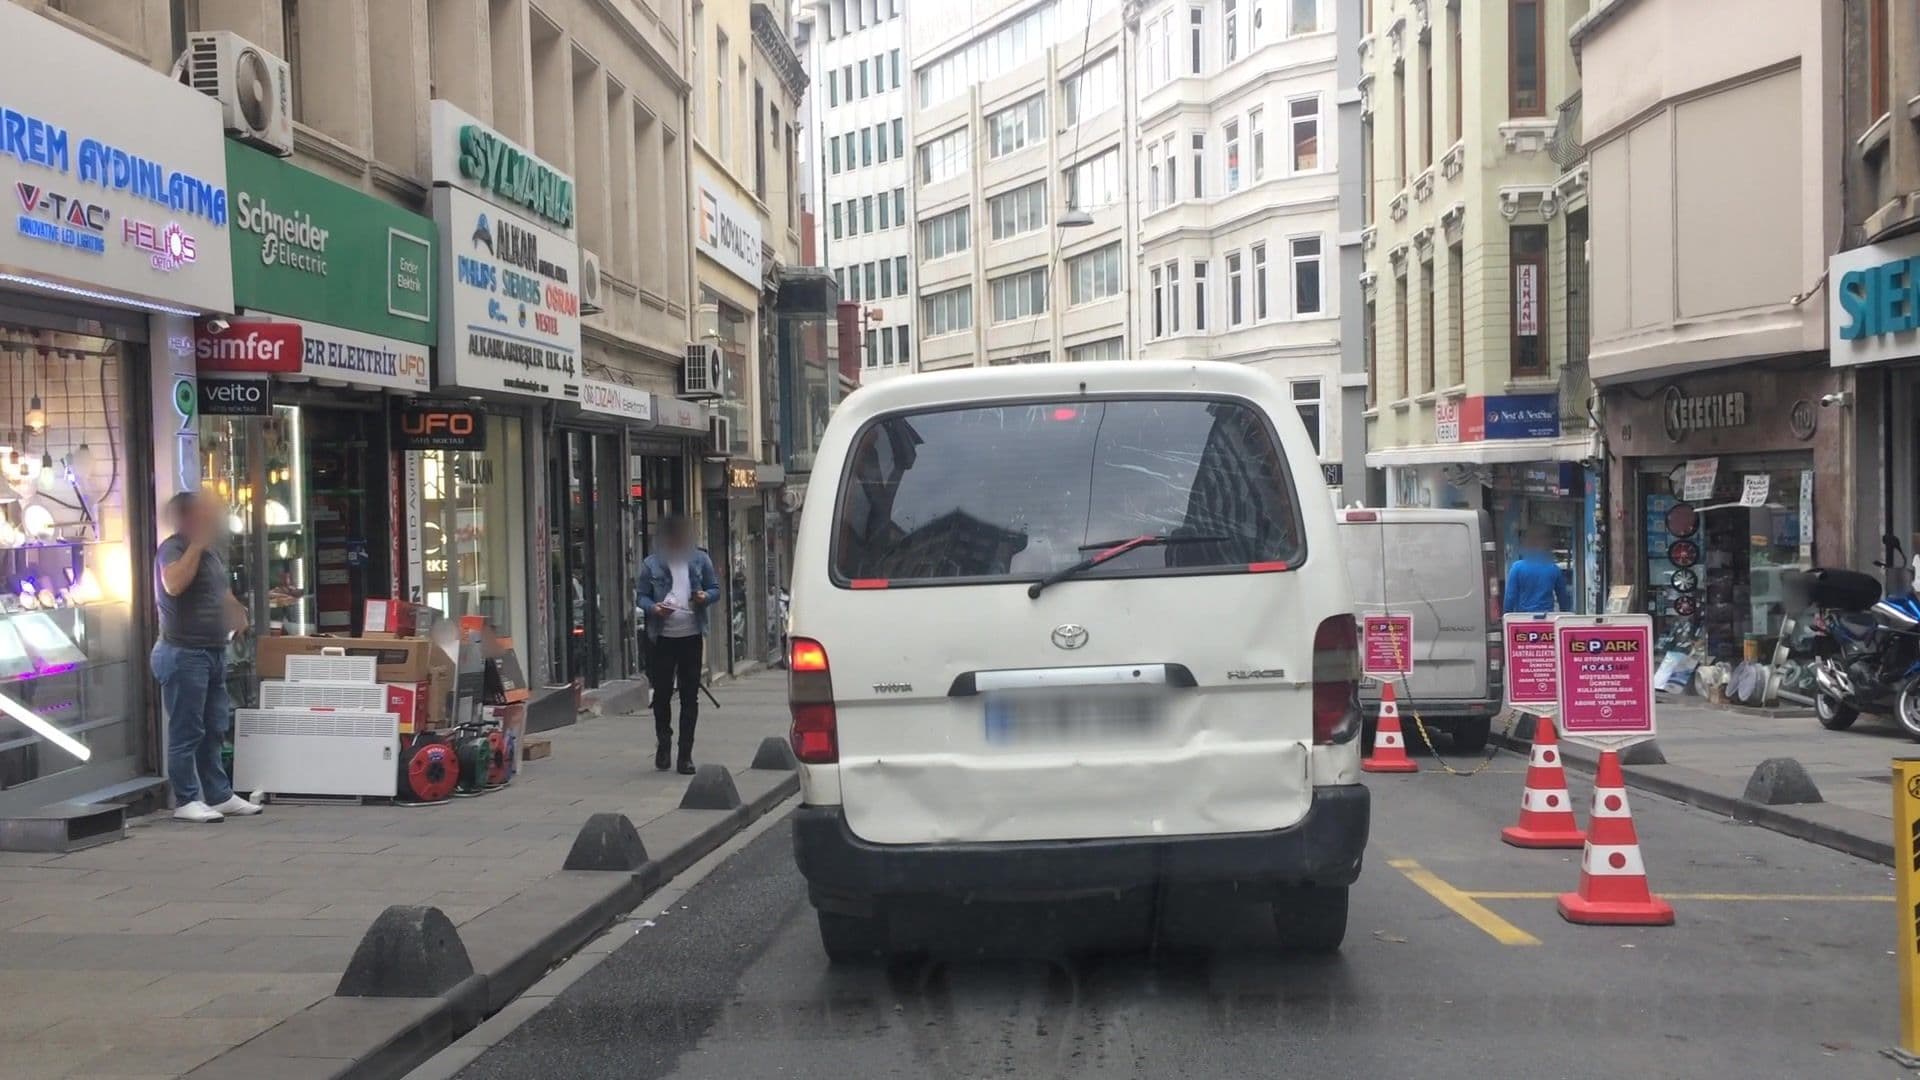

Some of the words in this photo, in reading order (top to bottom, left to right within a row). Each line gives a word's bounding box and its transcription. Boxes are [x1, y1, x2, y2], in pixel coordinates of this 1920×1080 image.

[78, 137, 226, 226] AYDINLATMA
[459, 123, 573, 229] SYLVANIA
[237, 191, 329, 252] Schneider
[278, 244, 327, 275] Electric
[496, 219, 537, 273] ALKAN
[196, 332, 284, 360] simfer
[206, 384, 260, 402] veito
[402, 413, 473, 434] UFO
